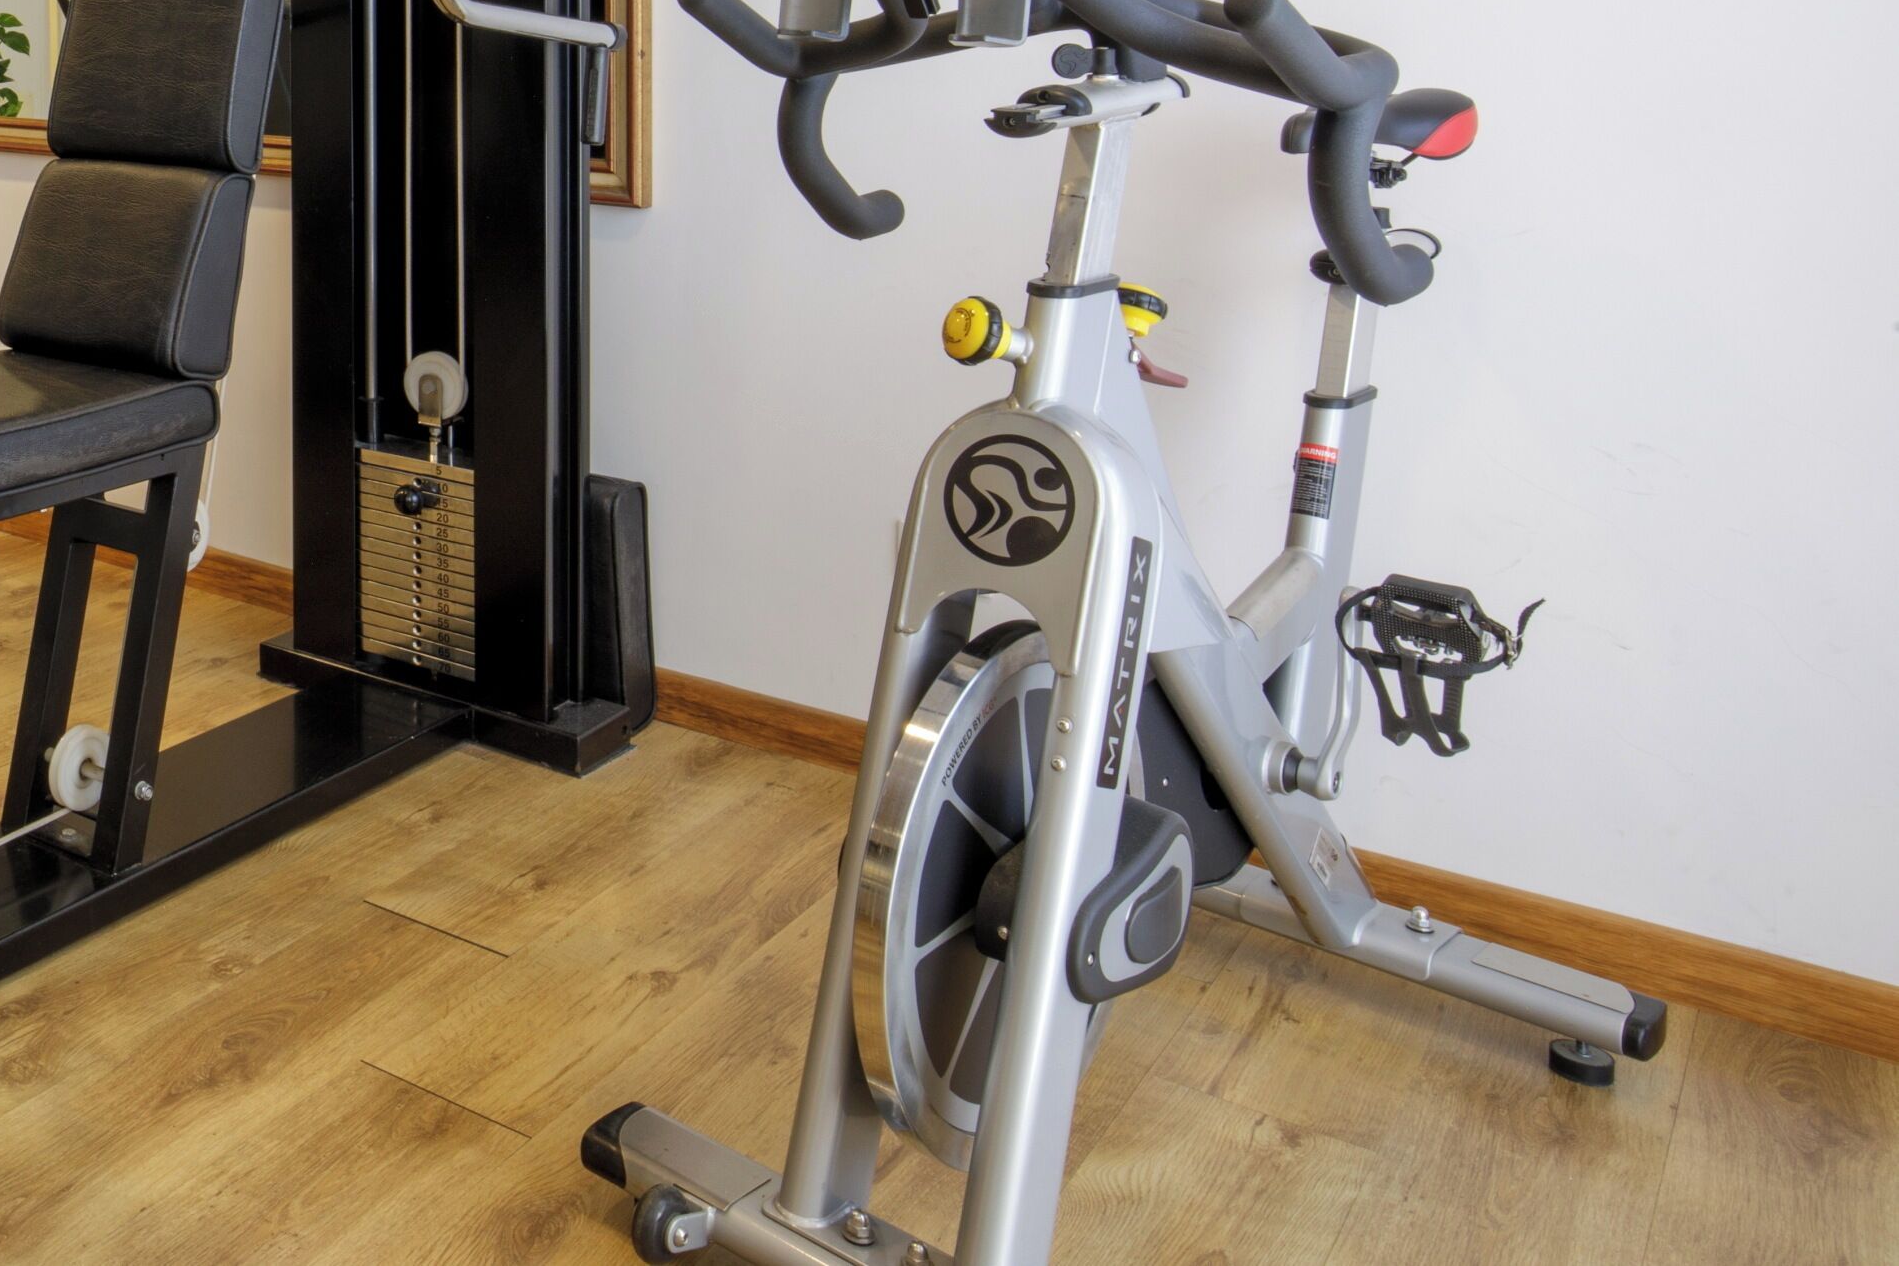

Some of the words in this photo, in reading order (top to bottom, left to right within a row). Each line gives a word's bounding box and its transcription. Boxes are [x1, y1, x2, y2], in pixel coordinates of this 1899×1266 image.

[1301, 447, 1337, 460] WARNING
[436, 466, 442, 475] 5
[436, 513, 449, 524] 20
[436, 528, 449, 539] 25
[436, 542, 449, 554] 30
[437, 558, 449, 569] 35
[437, 573, 450, 584] 40
[437, 588, 450, 599] 45
[437, 603, 450, 614] 50
[437, 617, 450, 629] 55
[437, 632, 450, 643] 60
[437, 646, 450, 658] 65
[438, 661, 451, 673] 70
[1103, 553, 1147, 776] MATRIX
[941, 728, 973, 787] POWERED
[972, 714, 982, 731] BY
